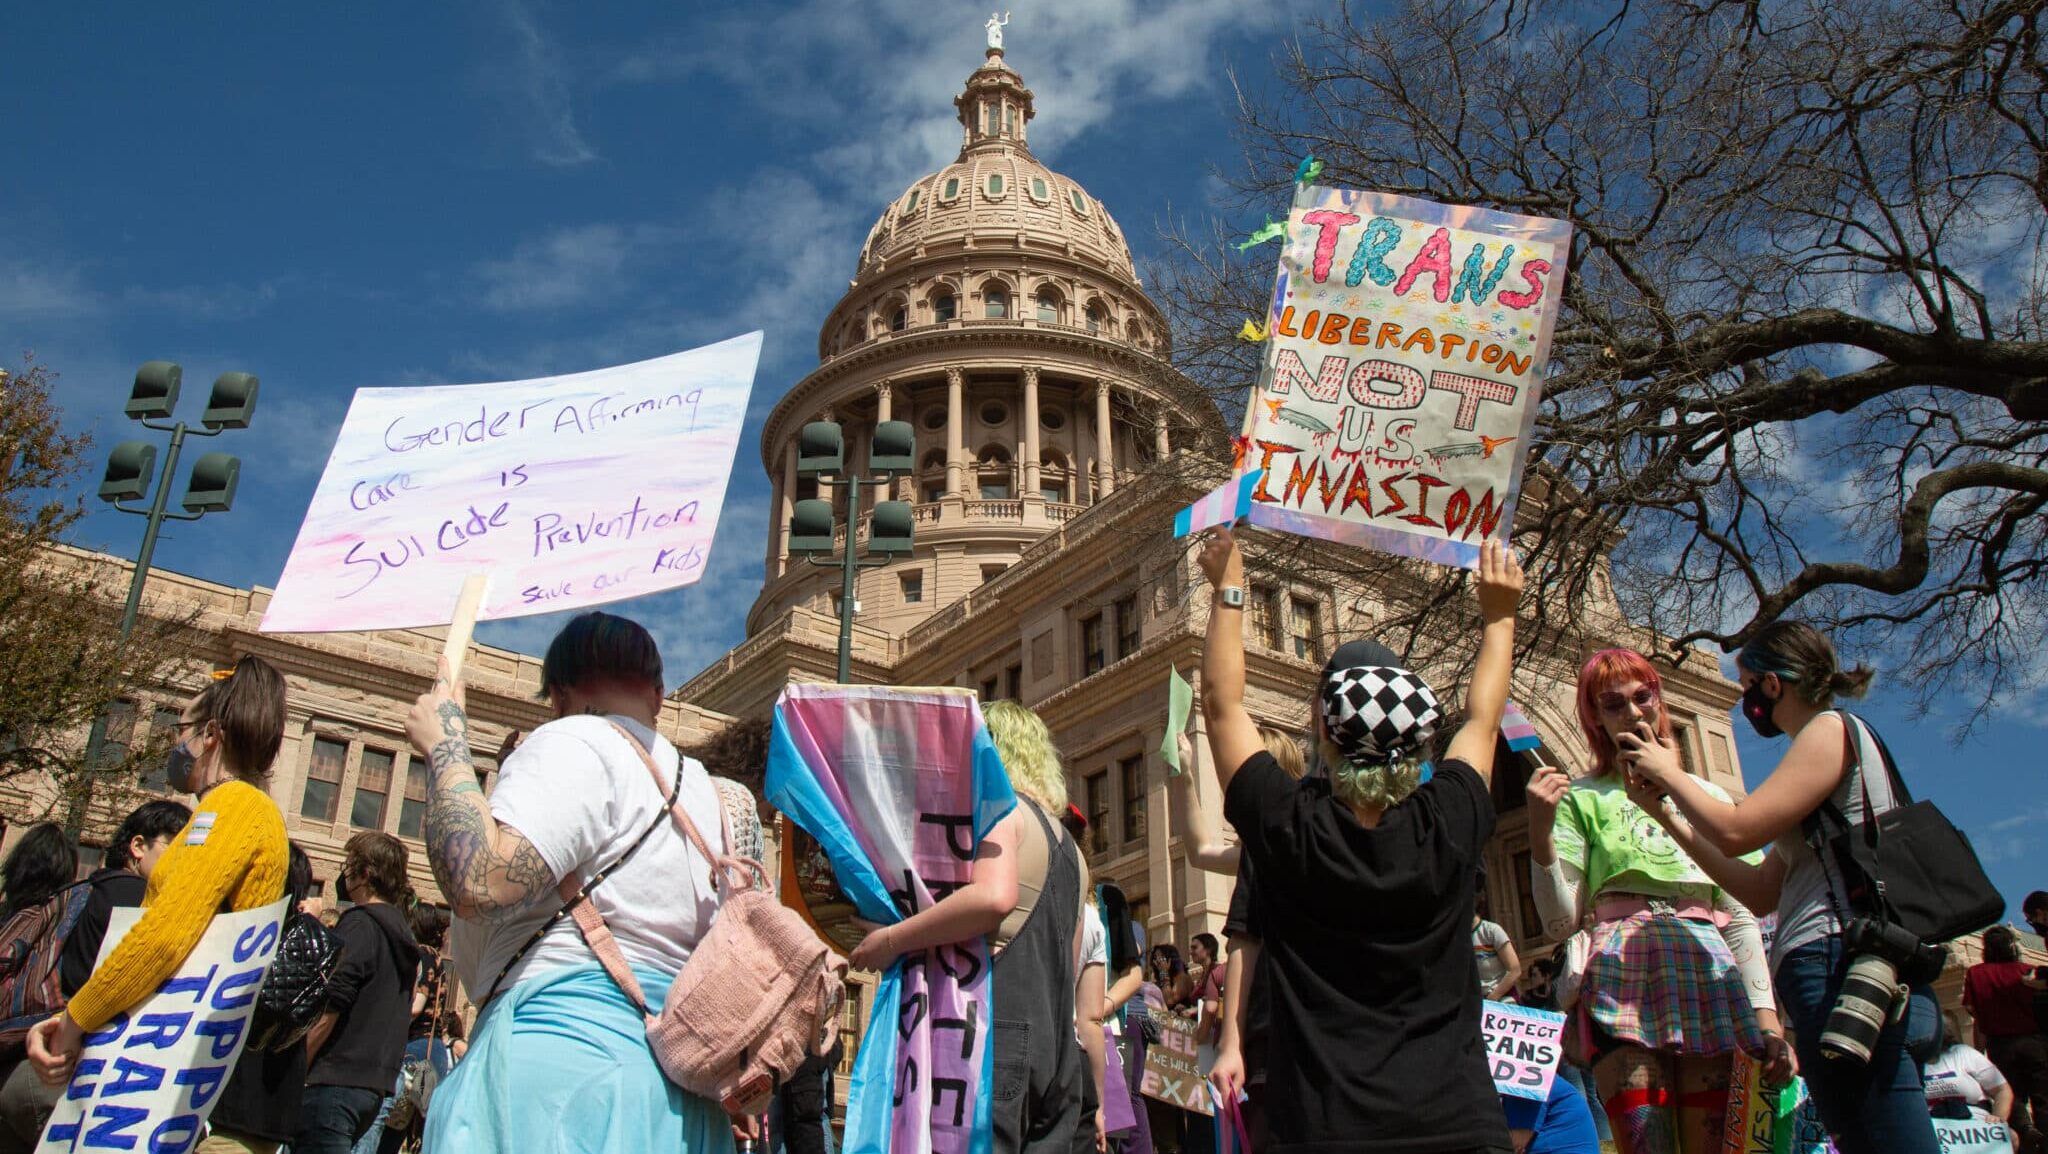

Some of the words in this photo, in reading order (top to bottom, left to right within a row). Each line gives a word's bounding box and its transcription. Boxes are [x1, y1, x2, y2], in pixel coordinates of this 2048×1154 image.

[1302, 208, 1552, 311] TRANS
[1278, 304, 1534, 377] LIBERATION
[1270, 348, 1518, 433] NOT
[384, 397, 553, 453] Gender
[1334, 404, 1425, 464] U.S.
[1251, 438, 1504, 543] INVASION
[533, 495, 699, 558] Prevention
[1484, 1012, 1559, 1038] ROTECT
